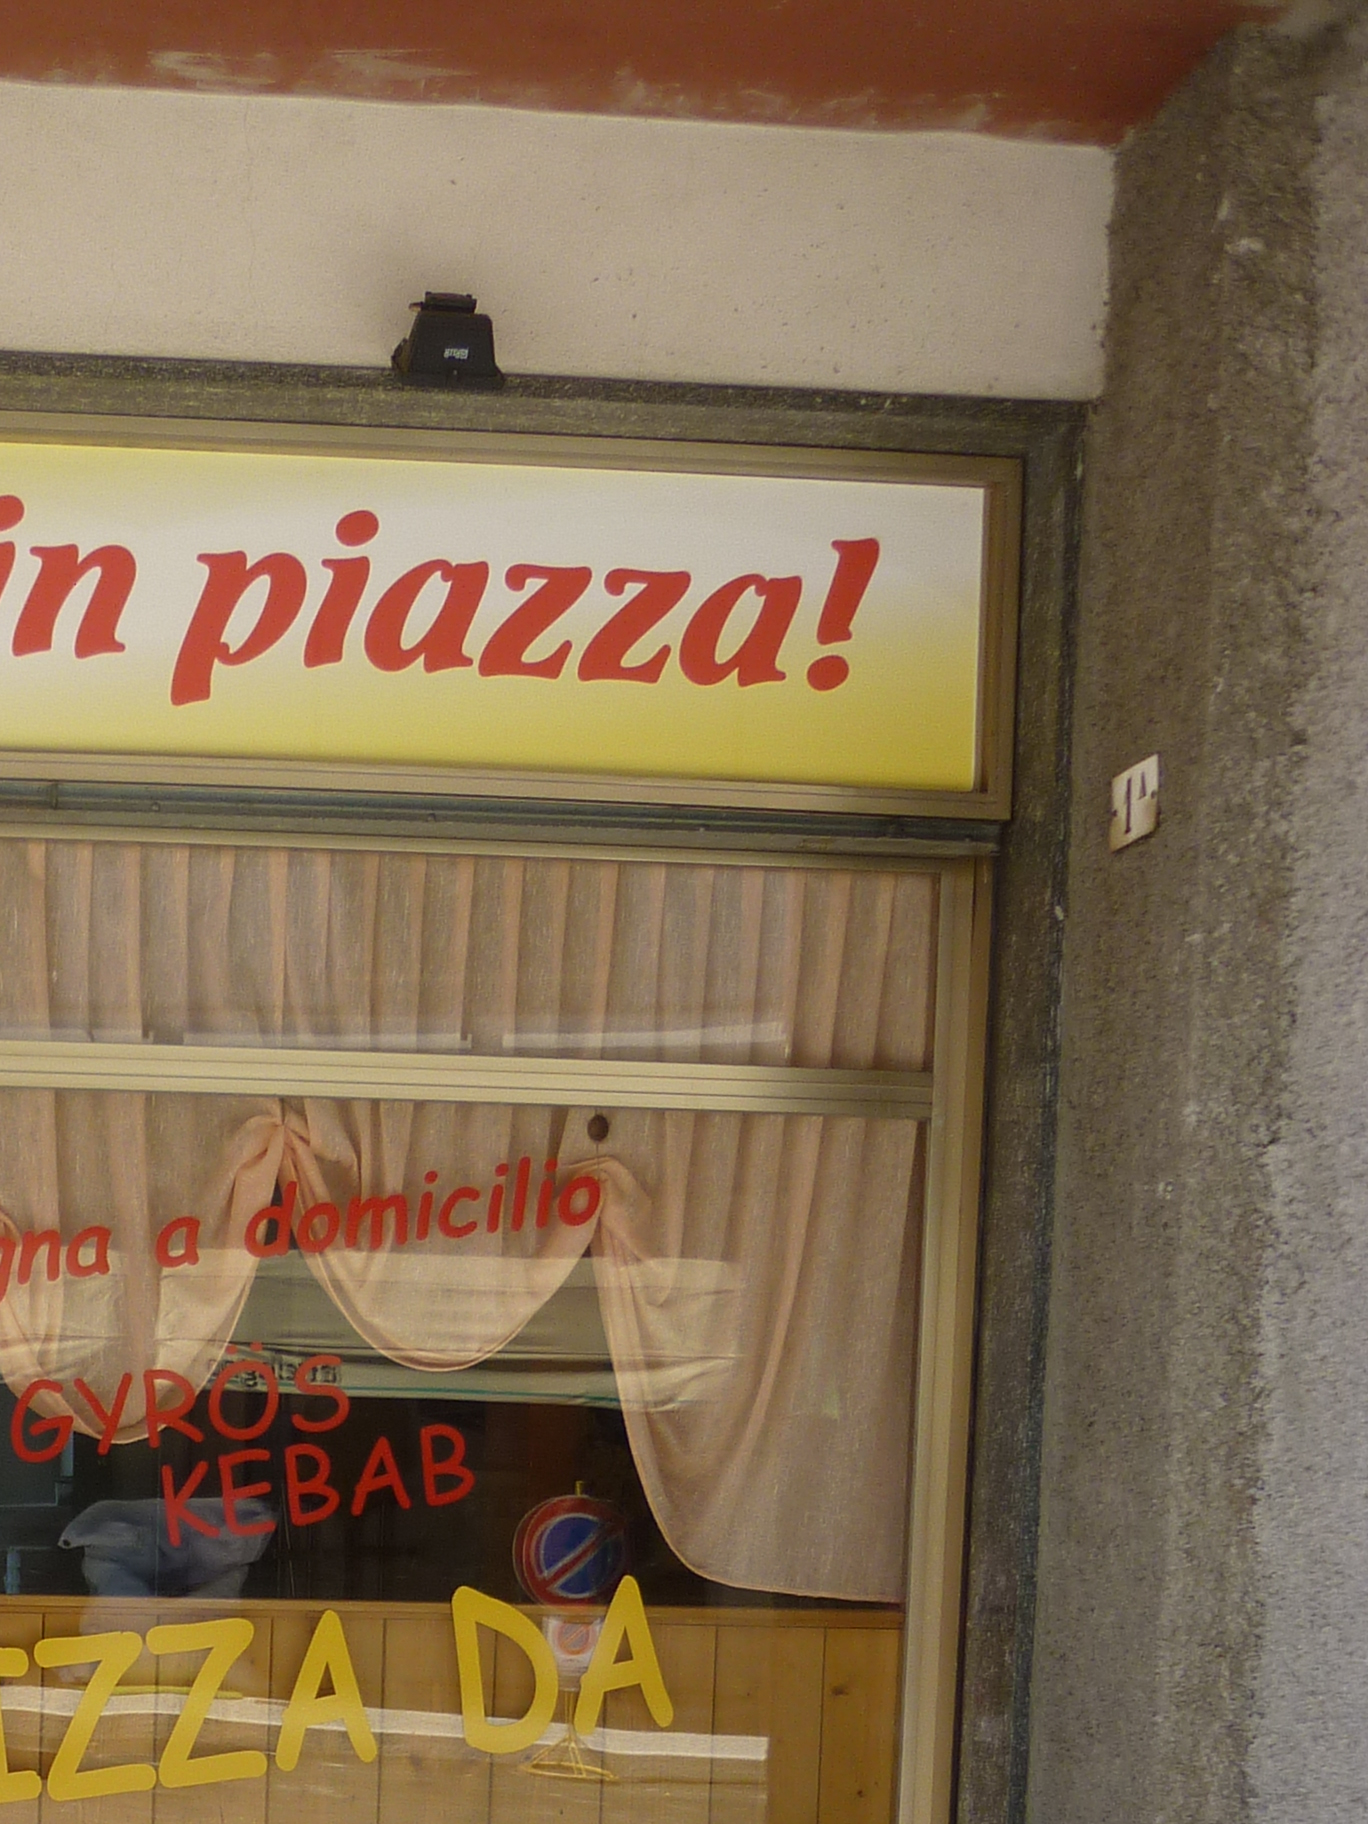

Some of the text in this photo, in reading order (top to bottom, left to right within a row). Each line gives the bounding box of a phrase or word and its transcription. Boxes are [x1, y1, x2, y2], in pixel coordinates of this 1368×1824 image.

[171, 511, 879, 706] piazza!
[155, 1216, 201, 1268] a
[244, 1157, 602, 1257] domicilio
[161, 1424, 475, 1546] KEBAB
[451, 1575, 675, 1756] DA
